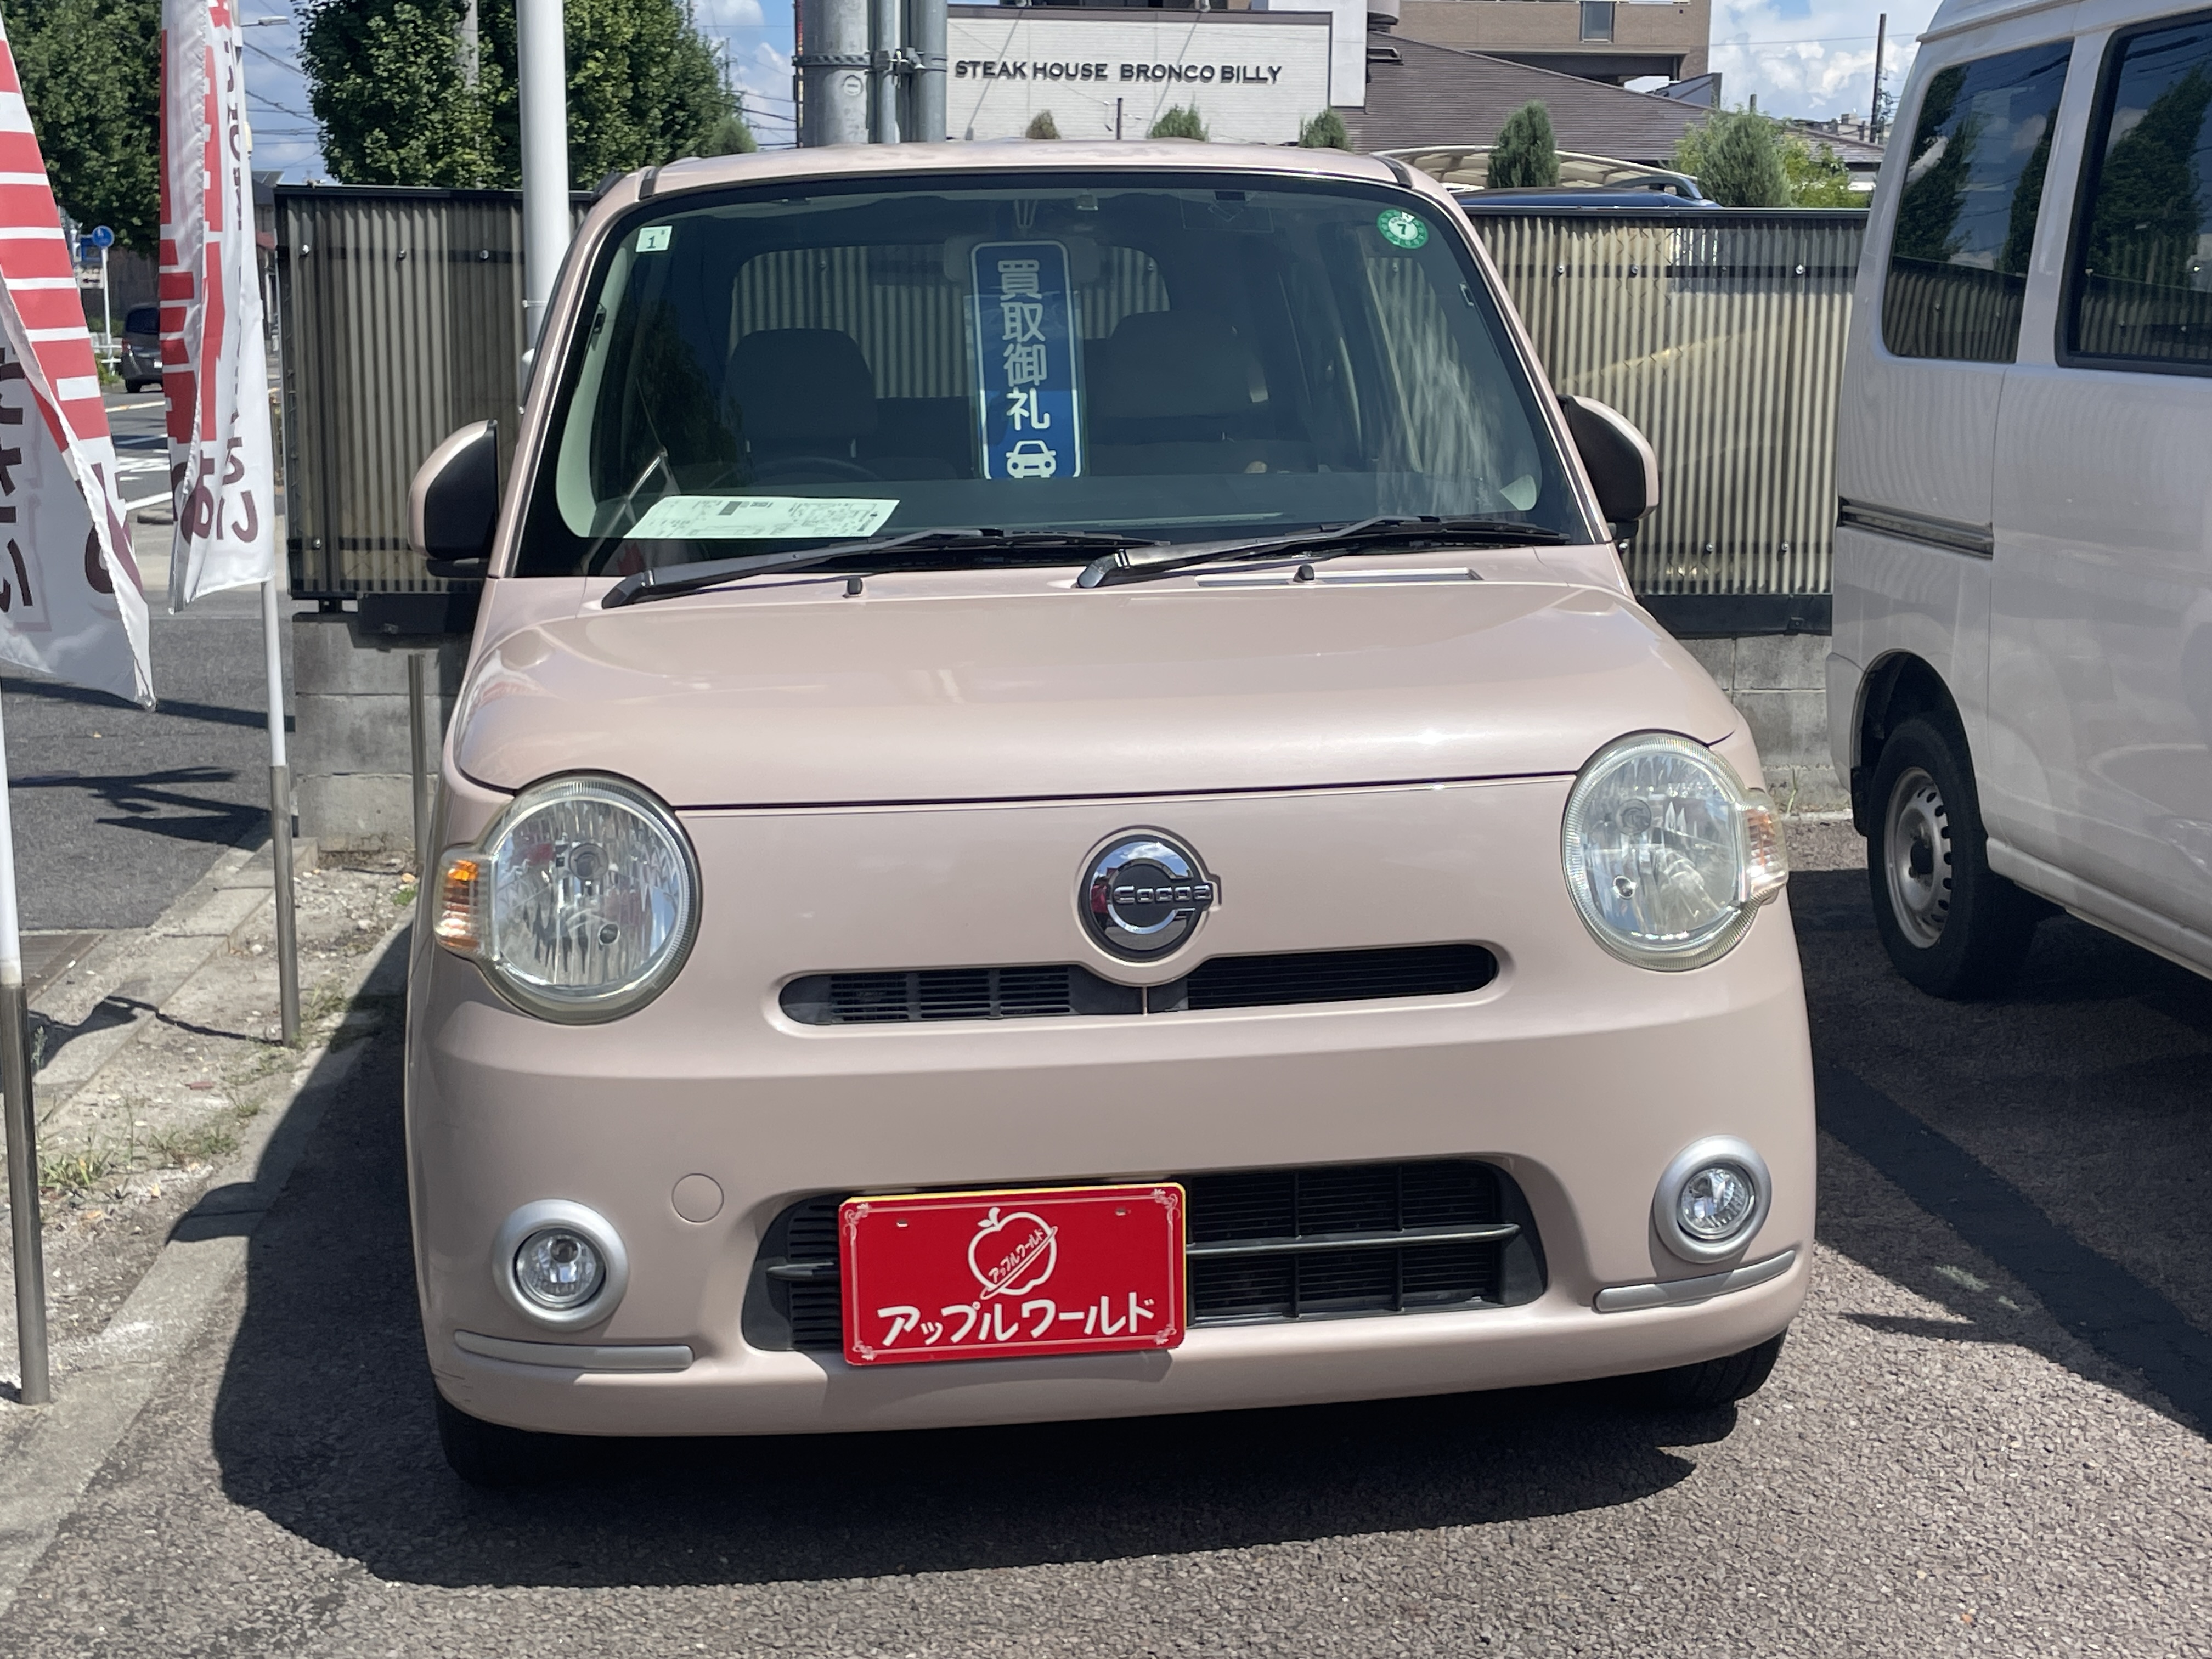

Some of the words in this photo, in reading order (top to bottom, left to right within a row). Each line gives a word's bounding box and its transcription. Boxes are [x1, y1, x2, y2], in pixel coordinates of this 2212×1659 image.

[955, 60, 1028, 80] STEAK
[1033, 62, 1108, 81] HOUSE
[1120, 64, 1215, 83] BRONCO
[1220, 65, 1282, 84] BILLY
[646, 235, 656, 249] 1
[1397, 223, 1407, 235] 7
[997, 259, 1051, 431] 買取御礼
[988, 1228, 1043, 1284] アップルワールド
[878, 1291, 1154, 1347] アップルワールド
